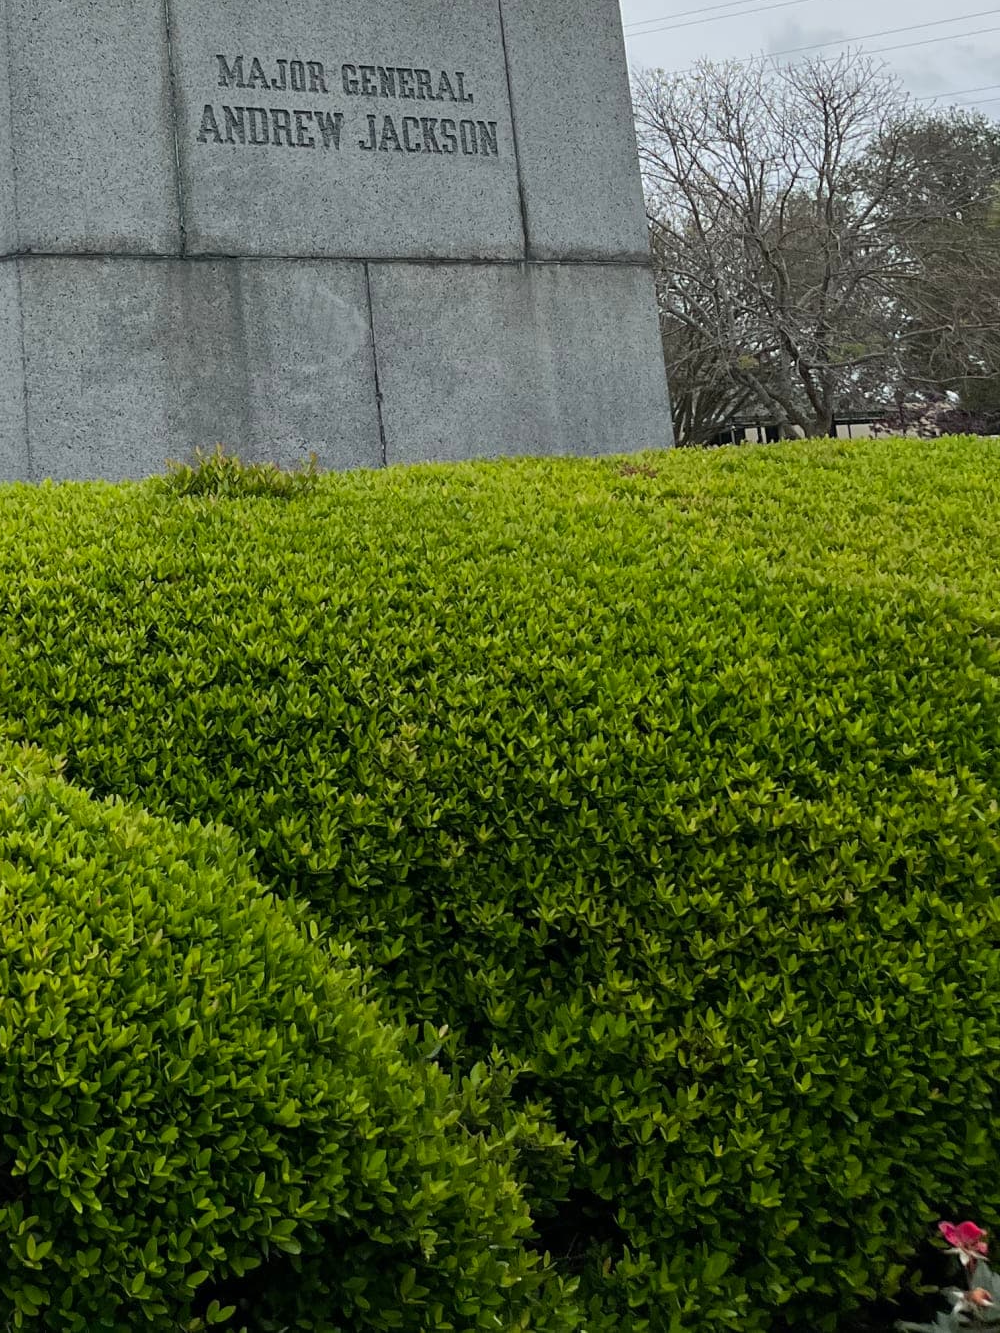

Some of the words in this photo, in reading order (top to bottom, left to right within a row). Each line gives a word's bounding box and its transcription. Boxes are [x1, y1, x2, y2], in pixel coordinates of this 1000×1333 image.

[216, 54, 329, 94] MAJOR
[341, 64, 474, 103] GENERAL
[196, 104, 344, 150] ANDREW
[358, 114, 498, 157] JACKSON
